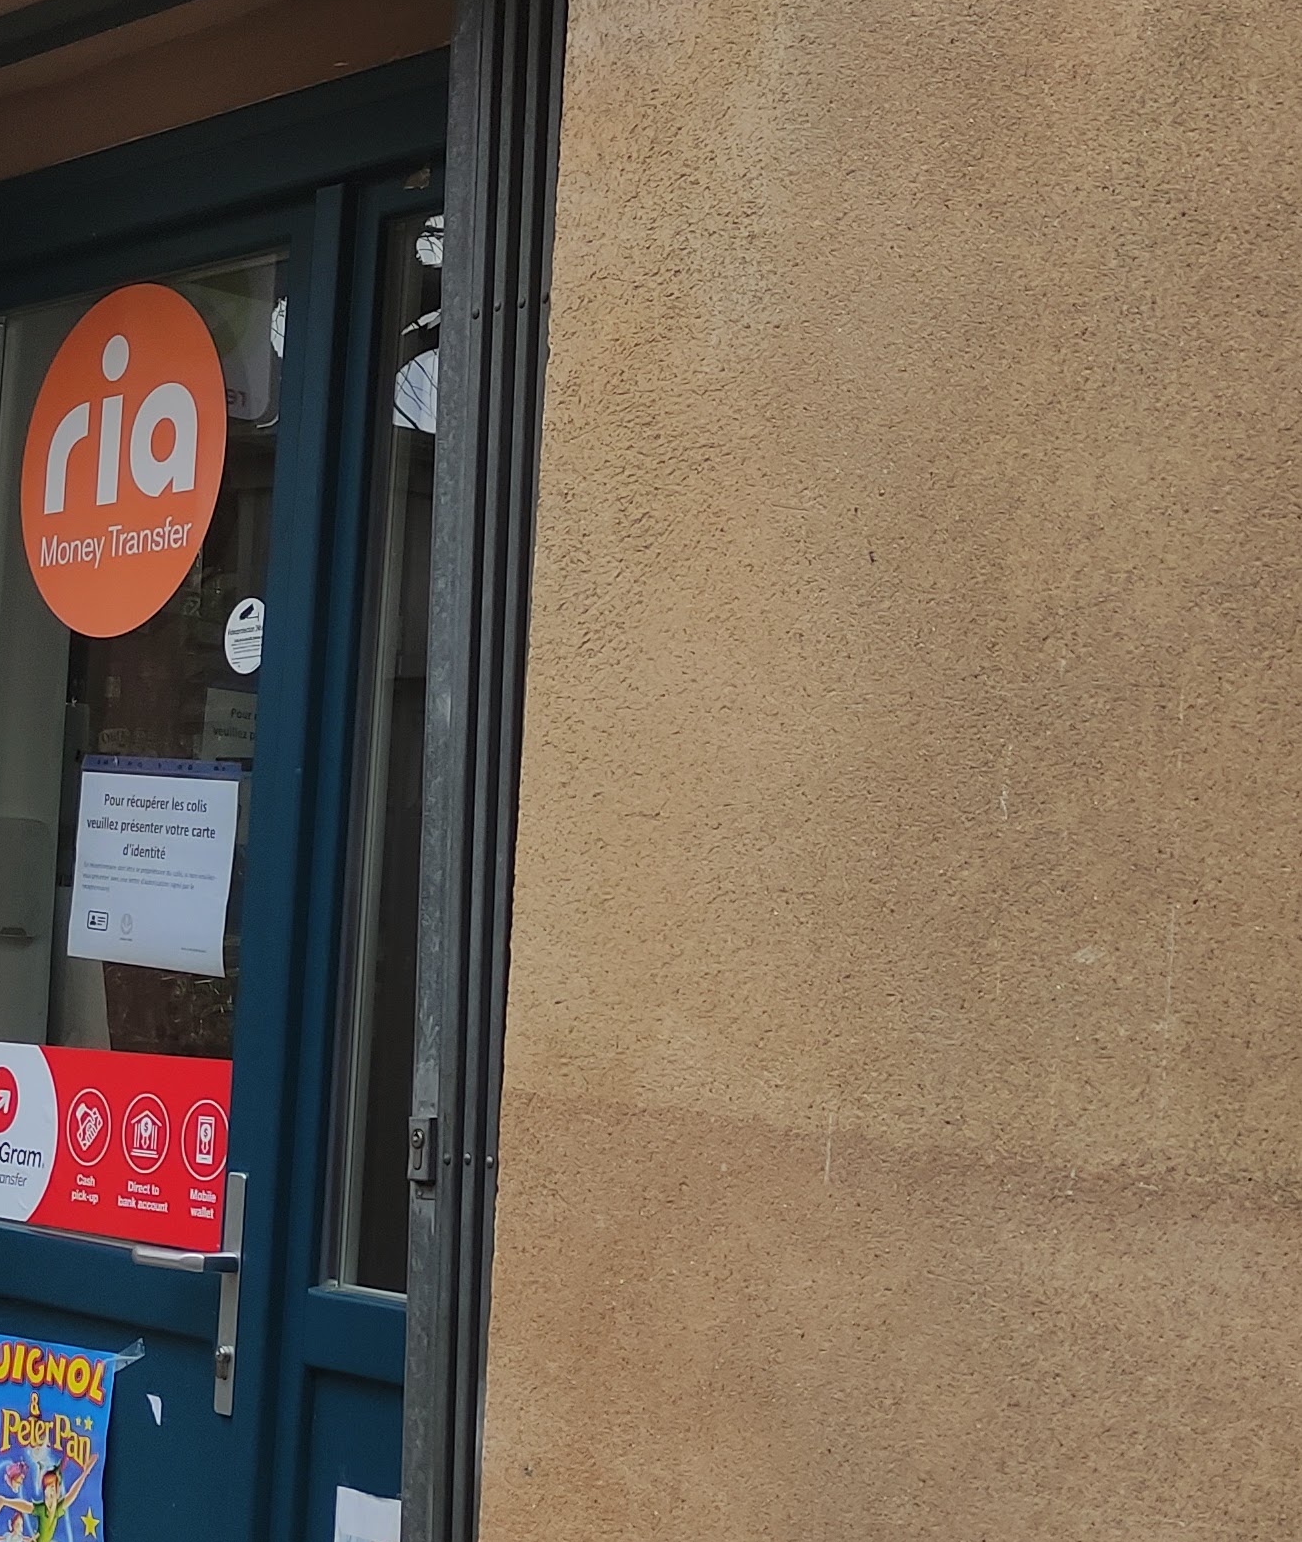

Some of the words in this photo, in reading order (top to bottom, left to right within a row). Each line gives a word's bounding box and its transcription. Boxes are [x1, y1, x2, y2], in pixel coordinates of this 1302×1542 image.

[44, 334, 198, 515] ria
[40, 534, 106, 569] Money
[108, 516, 193, 558] Transfer
[104, 794, 125, 807] Pour
[126, 795, 170, 811] récupérer
[172, 797, 184, 811] les
[186, 799, 208, 813] colis
[87, 817, 119, 832] veuillez
[120, 818, 163, 834] présenter
[165, 826, 190, 837] votre
[191, 826, 216, 839] carte
[122, 844, 166, 860] d'identité
[76, 1174, 96, 1188] Cash
[128, 1181, 150, 1196] Direct
[151, 1184, 160, 1196] to
[71, 1189, 99, 1205] pick-up
[117, 1195, 136, 1209] bank
[137, 1198, 168, 1213] account
[189, 1188, 217, 1204] Mobile
[190, 1204, 215, 1220] wallet
[29, 1392, 40, 1416] &
[0, 1409, 54, 1454] Peter
[52, 1413, 91, 1470] Pan
